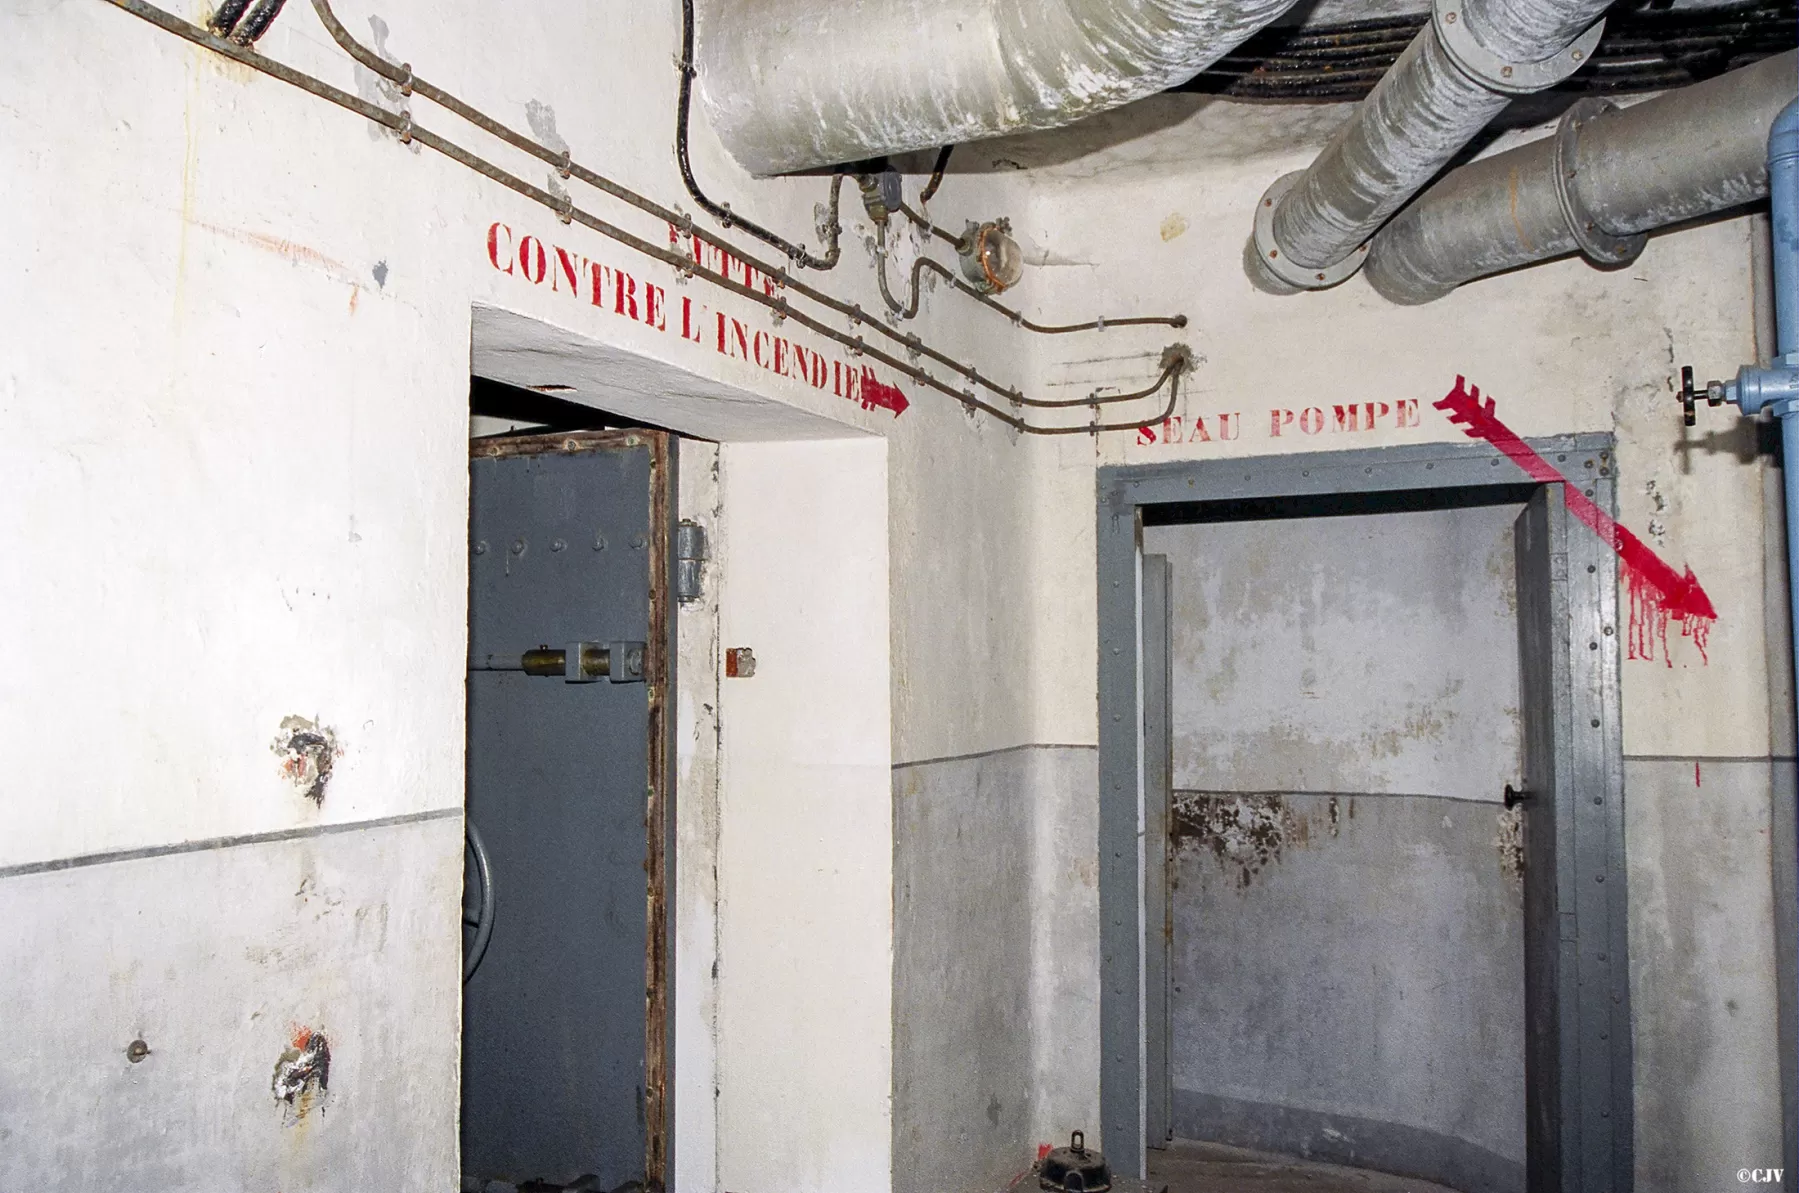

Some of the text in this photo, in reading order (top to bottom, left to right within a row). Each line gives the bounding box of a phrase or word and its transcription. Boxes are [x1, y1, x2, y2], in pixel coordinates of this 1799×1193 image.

[487, 222, 666, 332] CONTRE
[1136, 398, 1421, 446] SEAU POMPE
